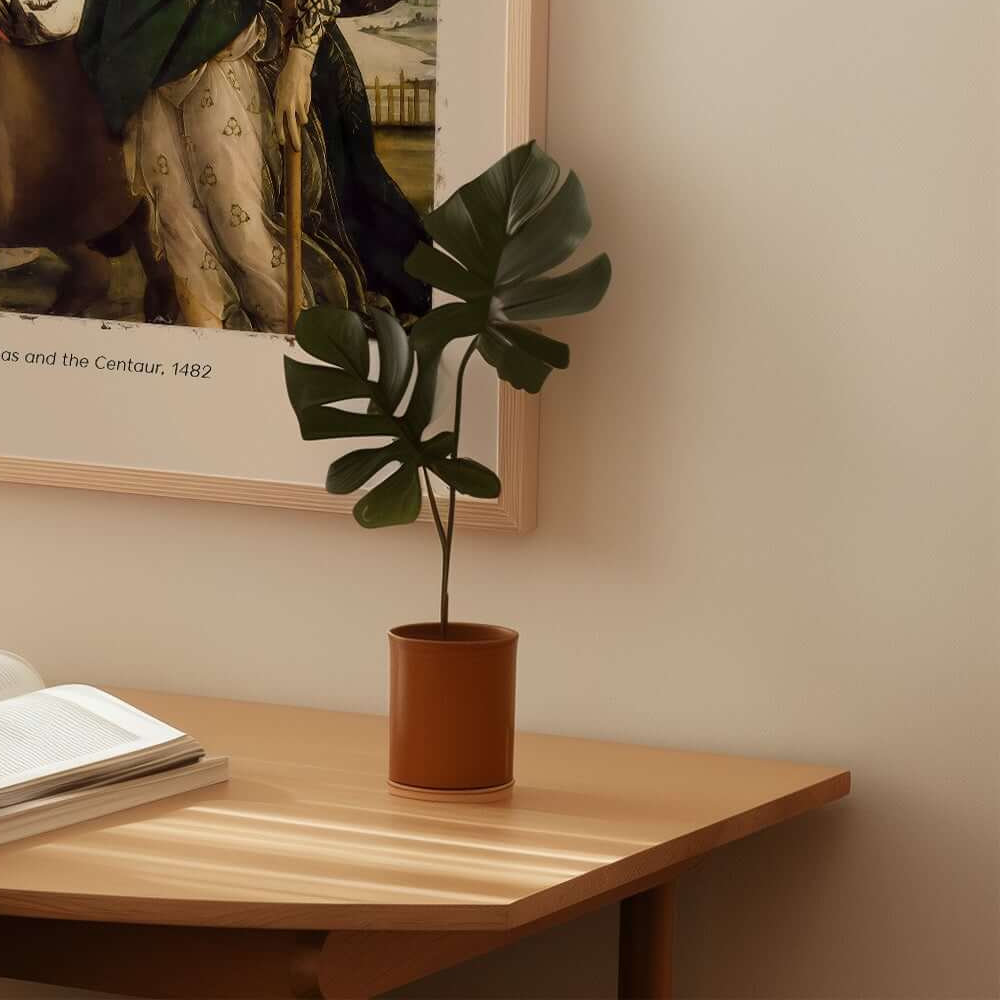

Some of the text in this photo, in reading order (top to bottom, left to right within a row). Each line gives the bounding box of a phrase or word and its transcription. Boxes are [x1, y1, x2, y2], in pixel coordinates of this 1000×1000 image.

[24, 351, 57, 366] and
[62, 353, 90, 369] the
[171, 362, 213, 379] 1482
